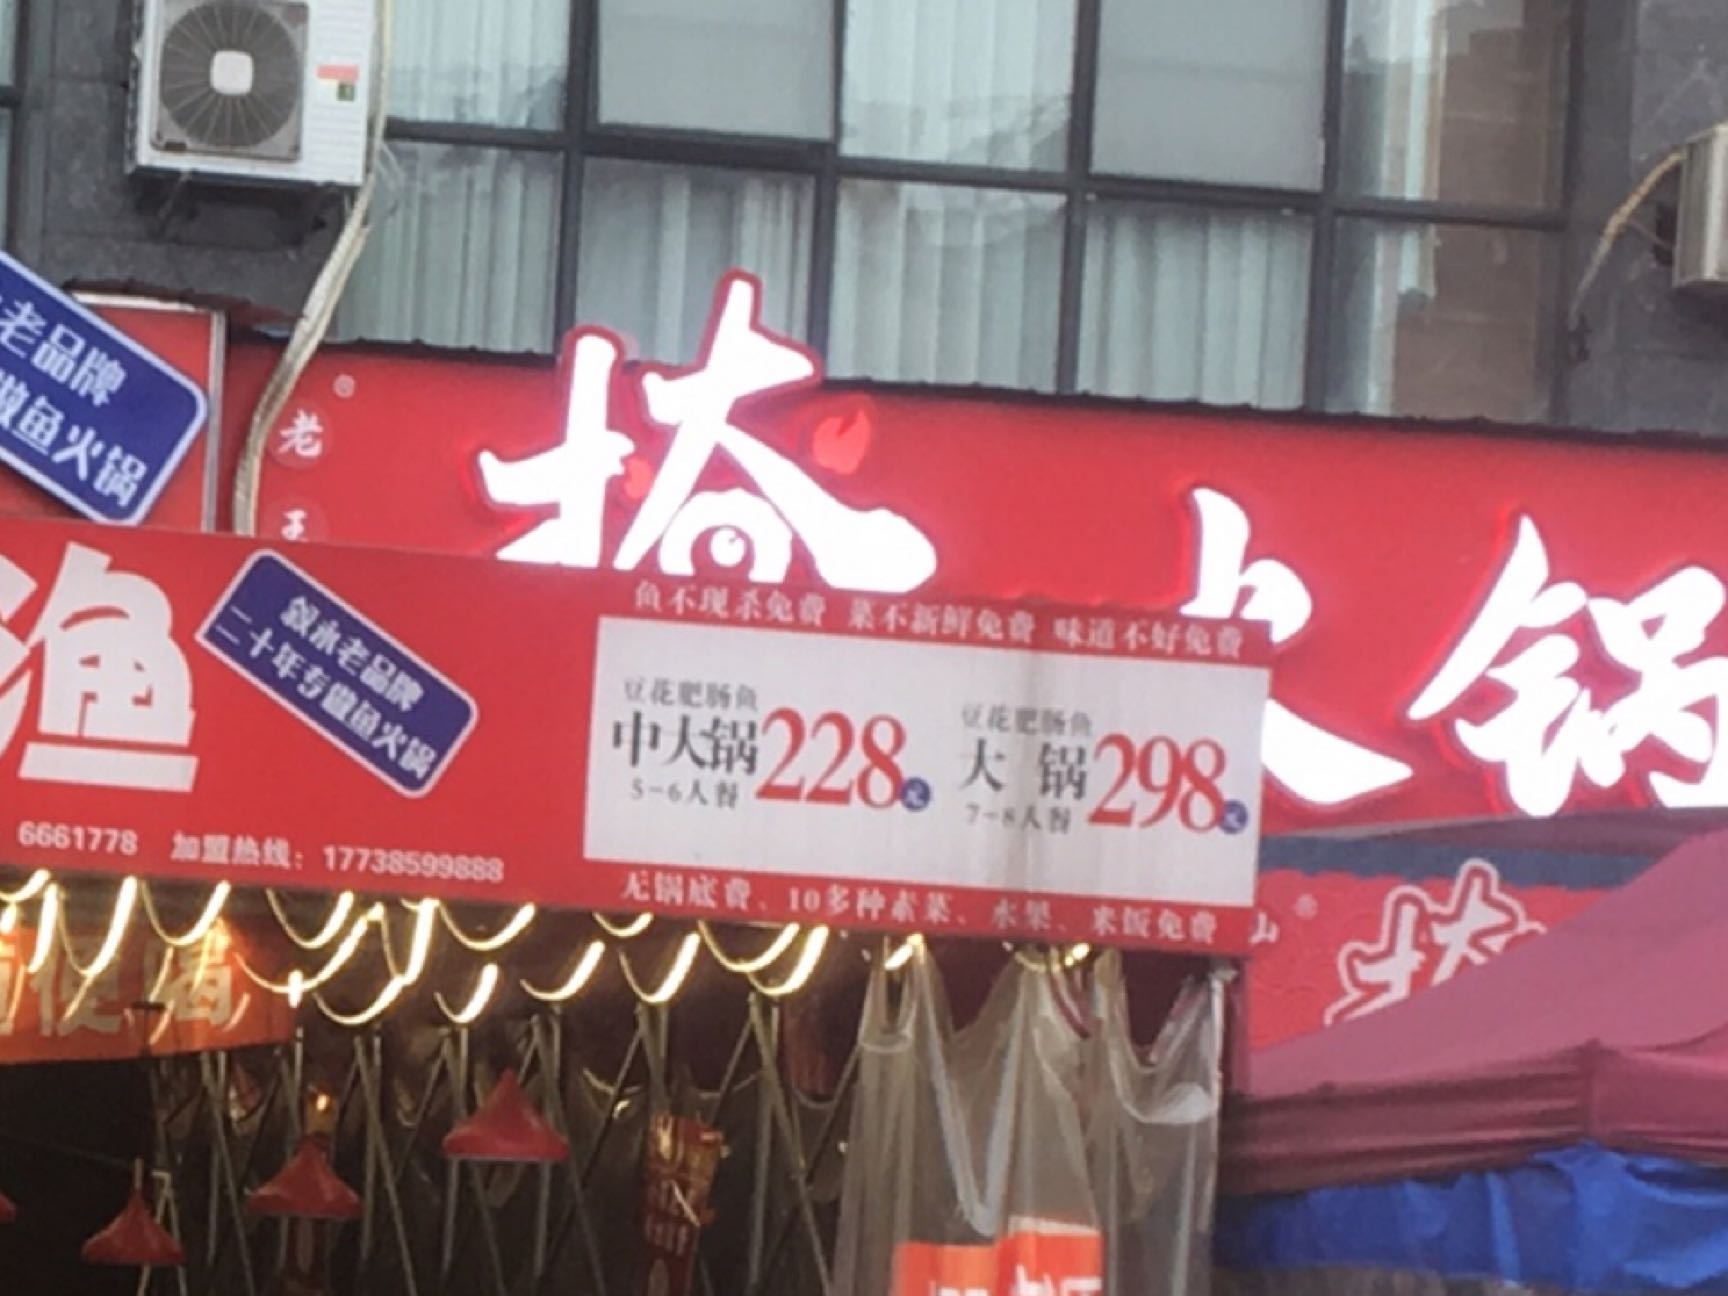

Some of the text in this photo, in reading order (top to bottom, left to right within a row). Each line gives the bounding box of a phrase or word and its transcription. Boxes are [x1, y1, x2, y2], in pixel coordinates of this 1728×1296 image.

[280, 596, 425, 713] 叙永老品牌
[633, 579, 827, 627] 鱼不现杀免费
[1052, 616, 1244, 659] 味道不好免费
[215, 604, 438, 781] 二十年专做鱼火锅
[612, 710, 760, 776] 中大锅
